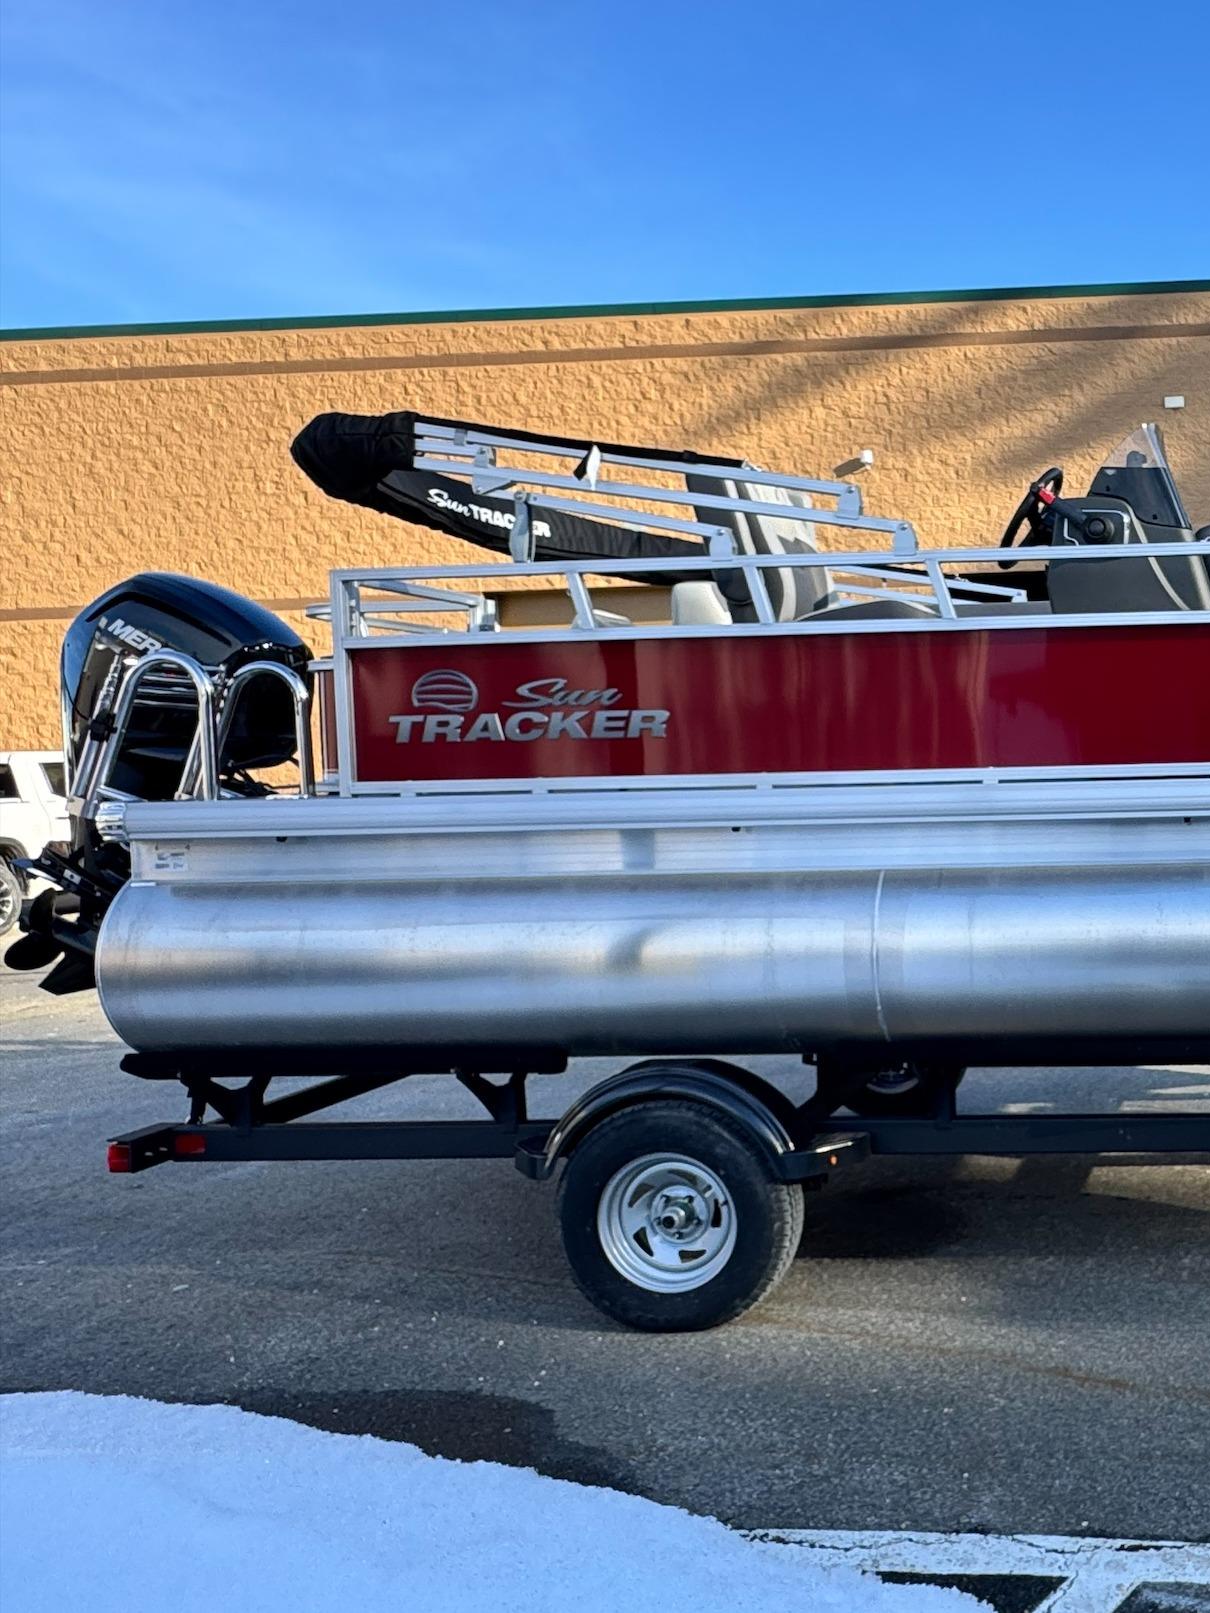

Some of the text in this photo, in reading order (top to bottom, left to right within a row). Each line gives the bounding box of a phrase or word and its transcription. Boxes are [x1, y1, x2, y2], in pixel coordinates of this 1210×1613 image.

[427, 488, 551, 538] Sun TRACER
[502, 677, 623, 708] Sun
[389, 710, 671, 743] TRACKER
